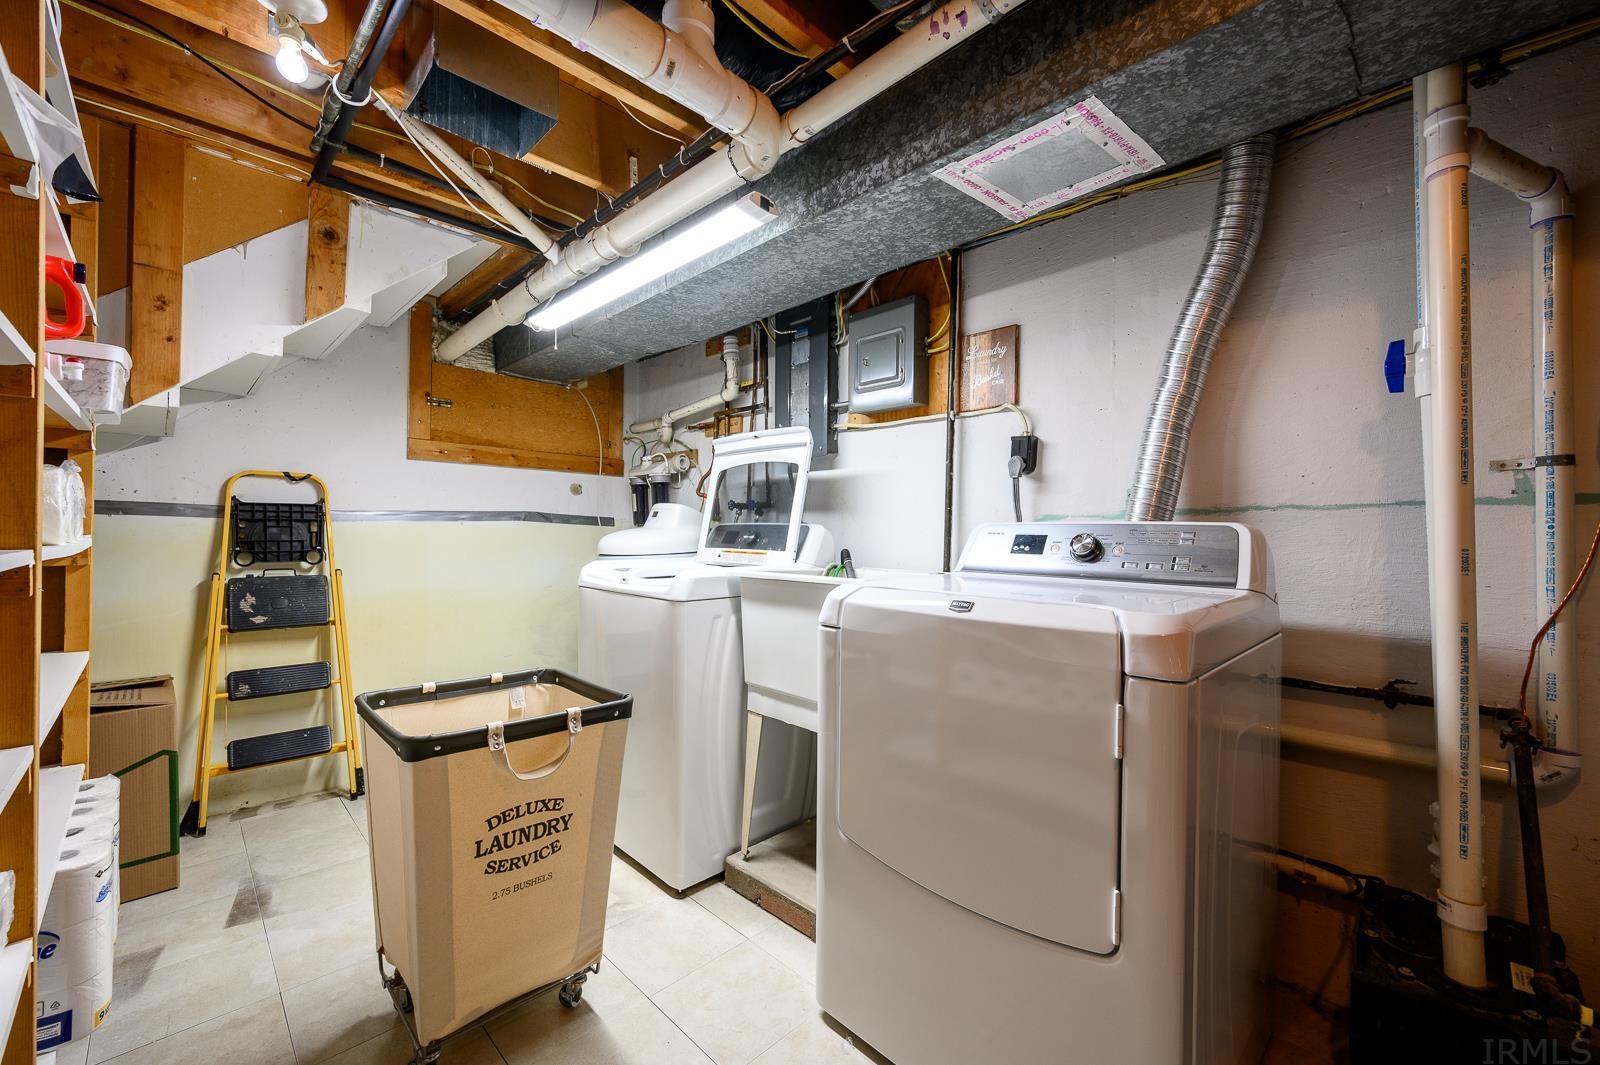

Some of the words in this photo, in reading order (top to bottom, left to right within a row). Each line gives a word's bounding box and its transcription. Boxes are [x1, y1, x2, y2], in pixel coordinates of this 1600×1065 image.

[966, 341, 1008, 361] Laundry
[484, 797, 565, 833] DELUXE
[474, 813, 574, 859] LAUNDRY
[484, 839, 562, 875] SERVICE
[491, 886, 512, 901] 2.75
[512, 872, 553, 893] BUSHELS
